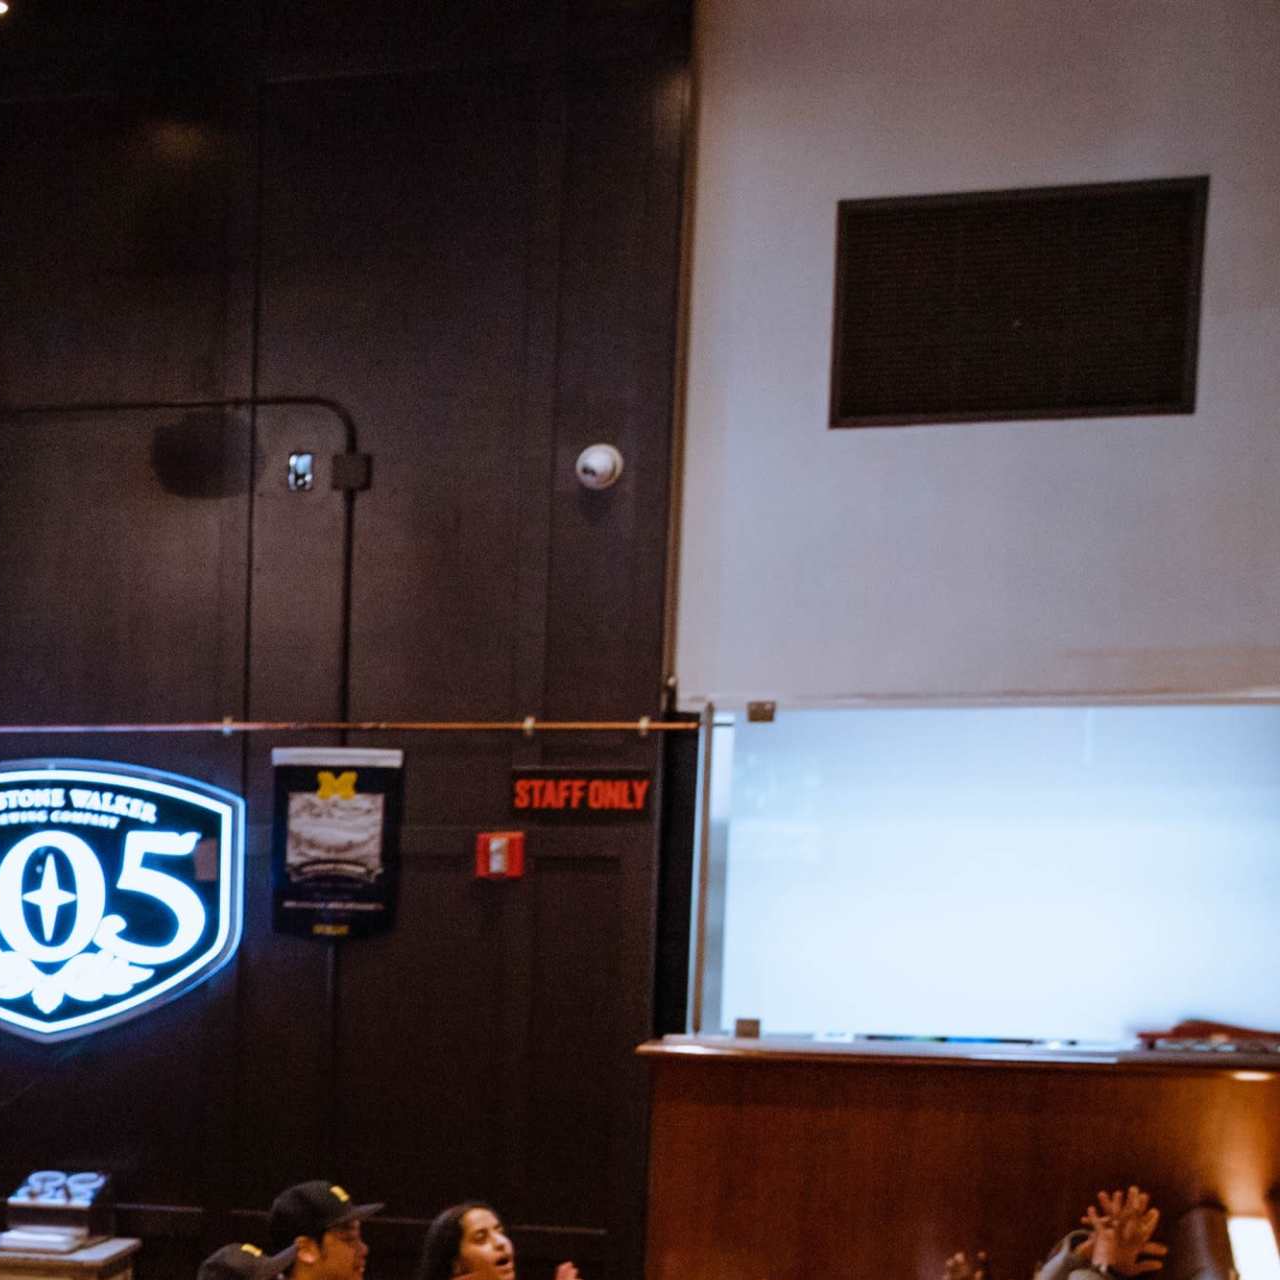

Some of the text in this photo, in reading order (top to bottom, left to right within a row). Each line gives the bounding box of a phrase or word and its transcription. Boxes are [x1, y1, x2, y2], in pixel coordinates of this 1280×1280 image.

[69, 788, 158, 824] WALKER
[513, 778, 650, 810] STAFF ONLY
[50, 809, 121, 830] COMPANY
